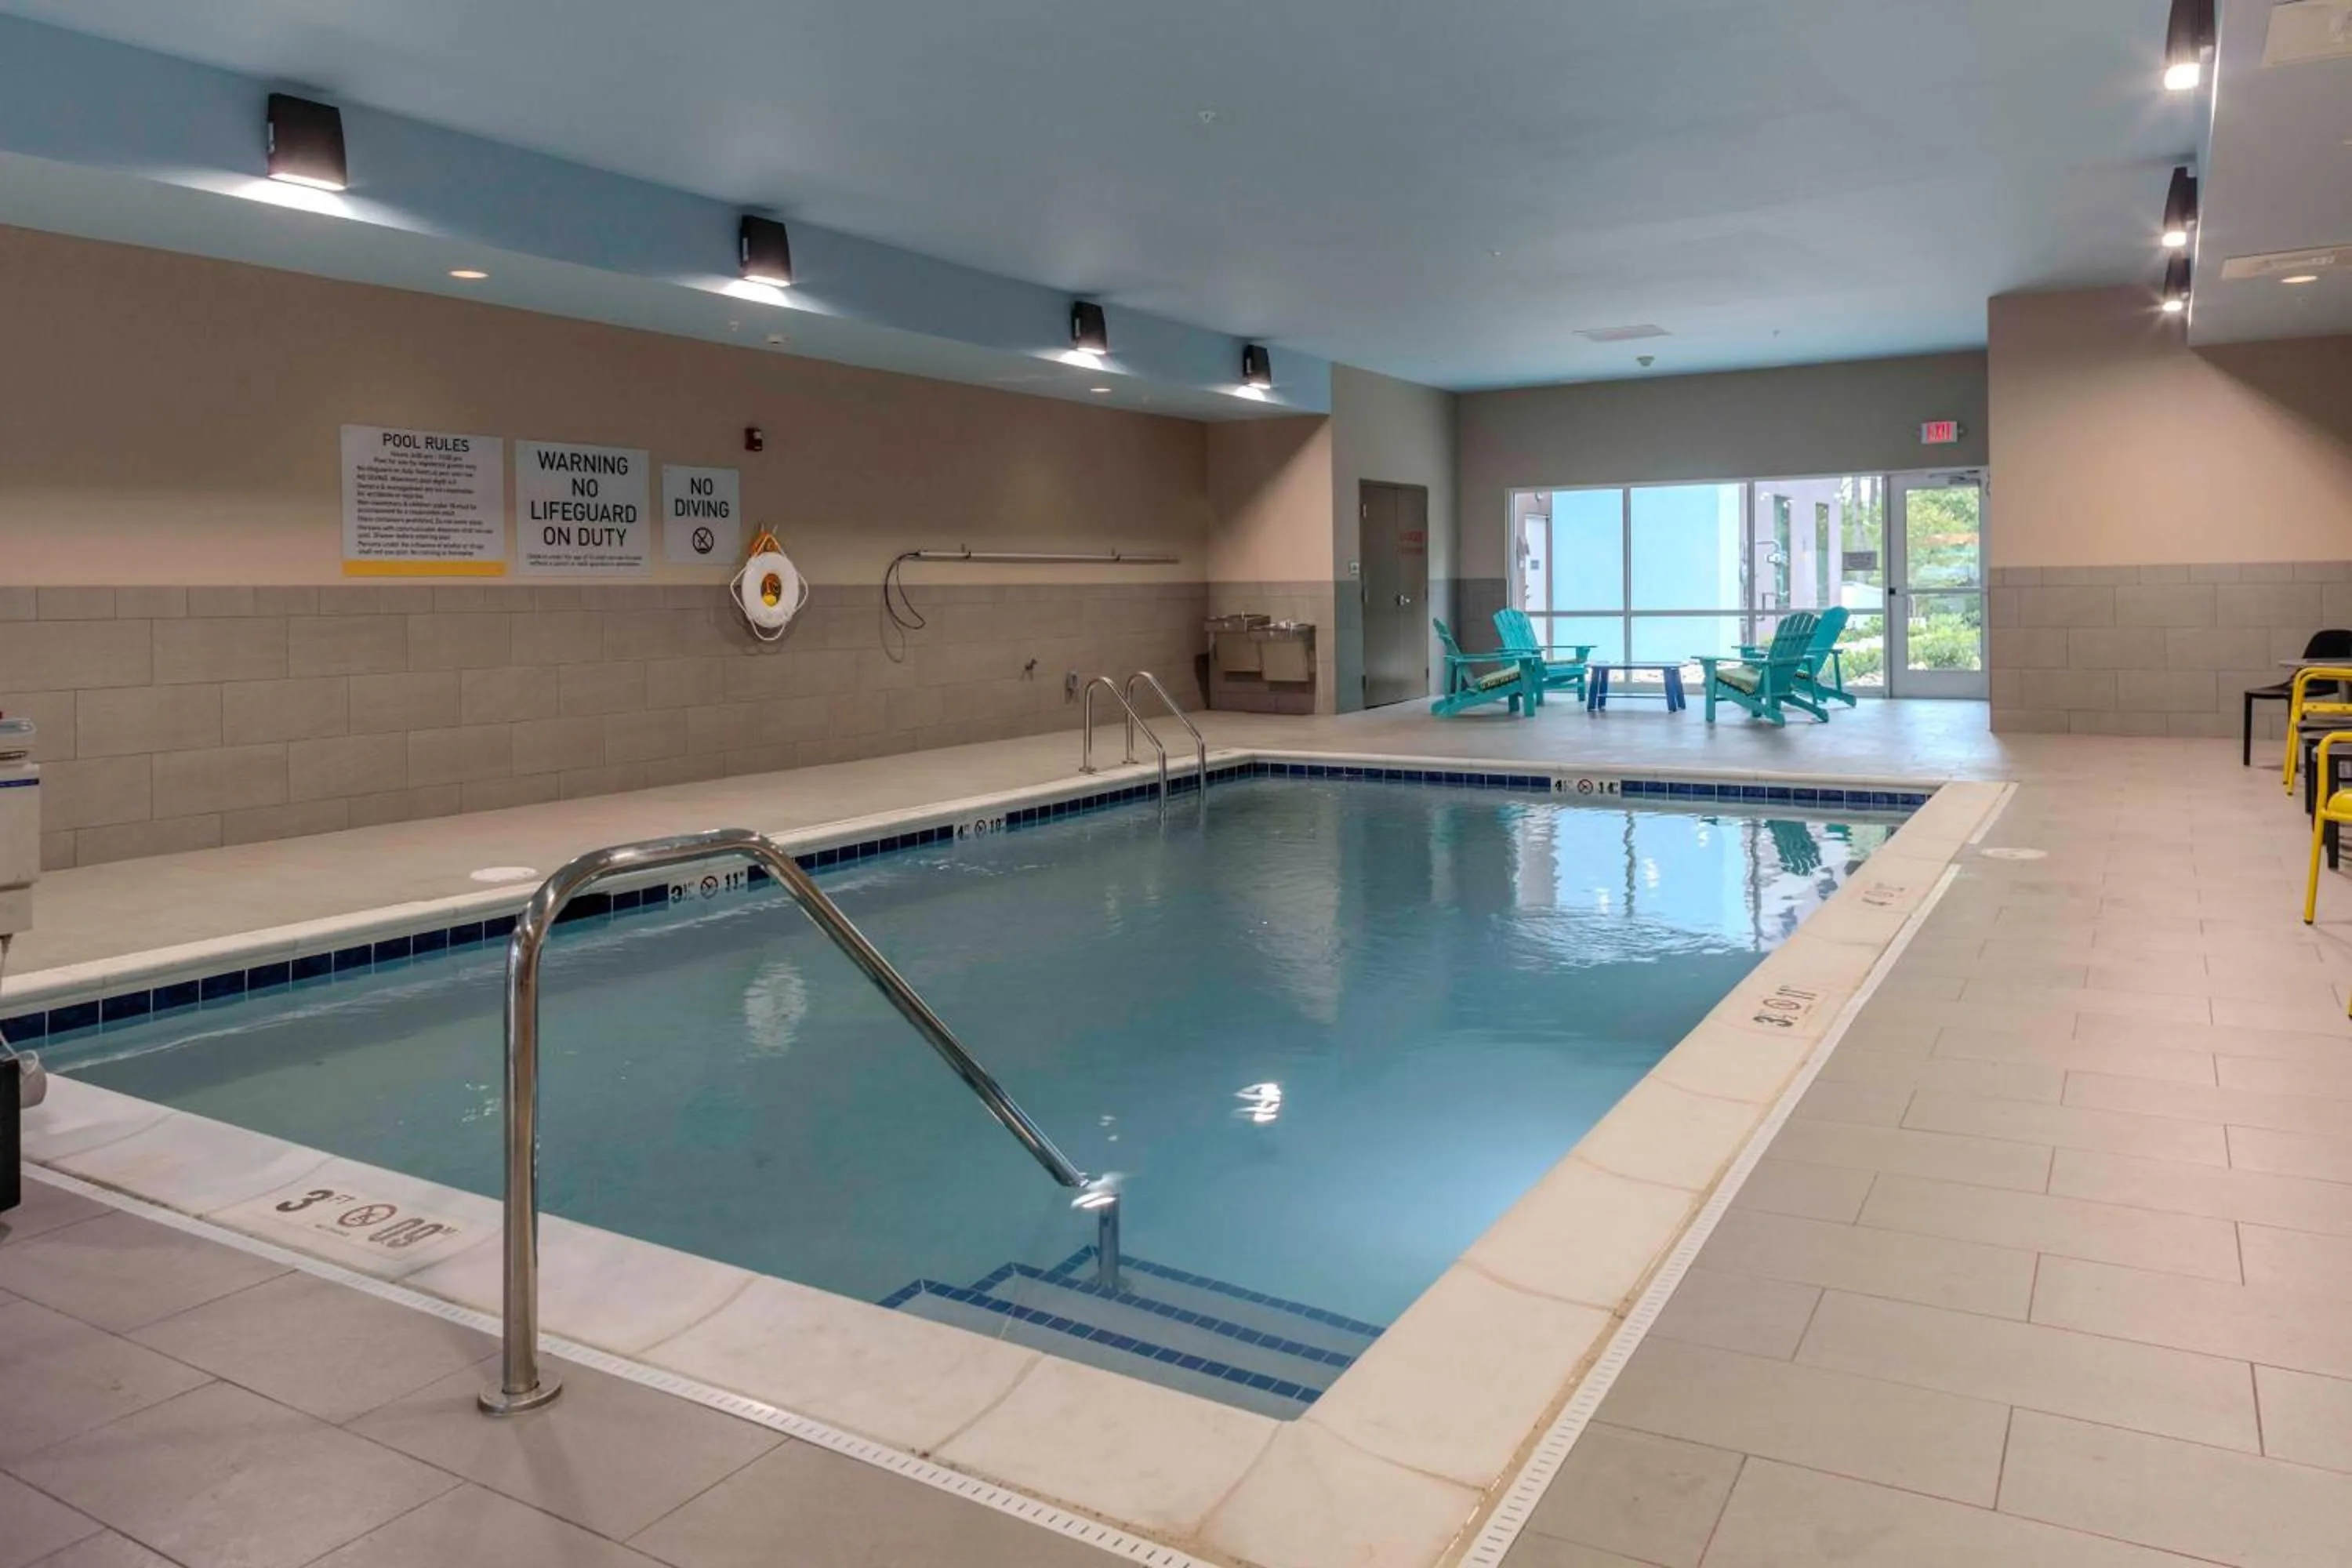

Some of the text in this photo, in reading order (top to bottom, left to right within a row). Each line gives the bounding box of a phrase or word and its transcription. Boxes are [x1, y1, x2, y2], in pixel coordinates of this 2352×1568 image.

[383, 433, 470, 452] POOL RULES
[538, 450, 628, 476] WARNING
[572, 477, 599, 498] NO
[690, 477, 713, 496] NO
[531, 500, 637, 524] LIFEGUARD
[674, 498, 730, 518] DIVING
[543, 526, 627, 546] ON DUTY
